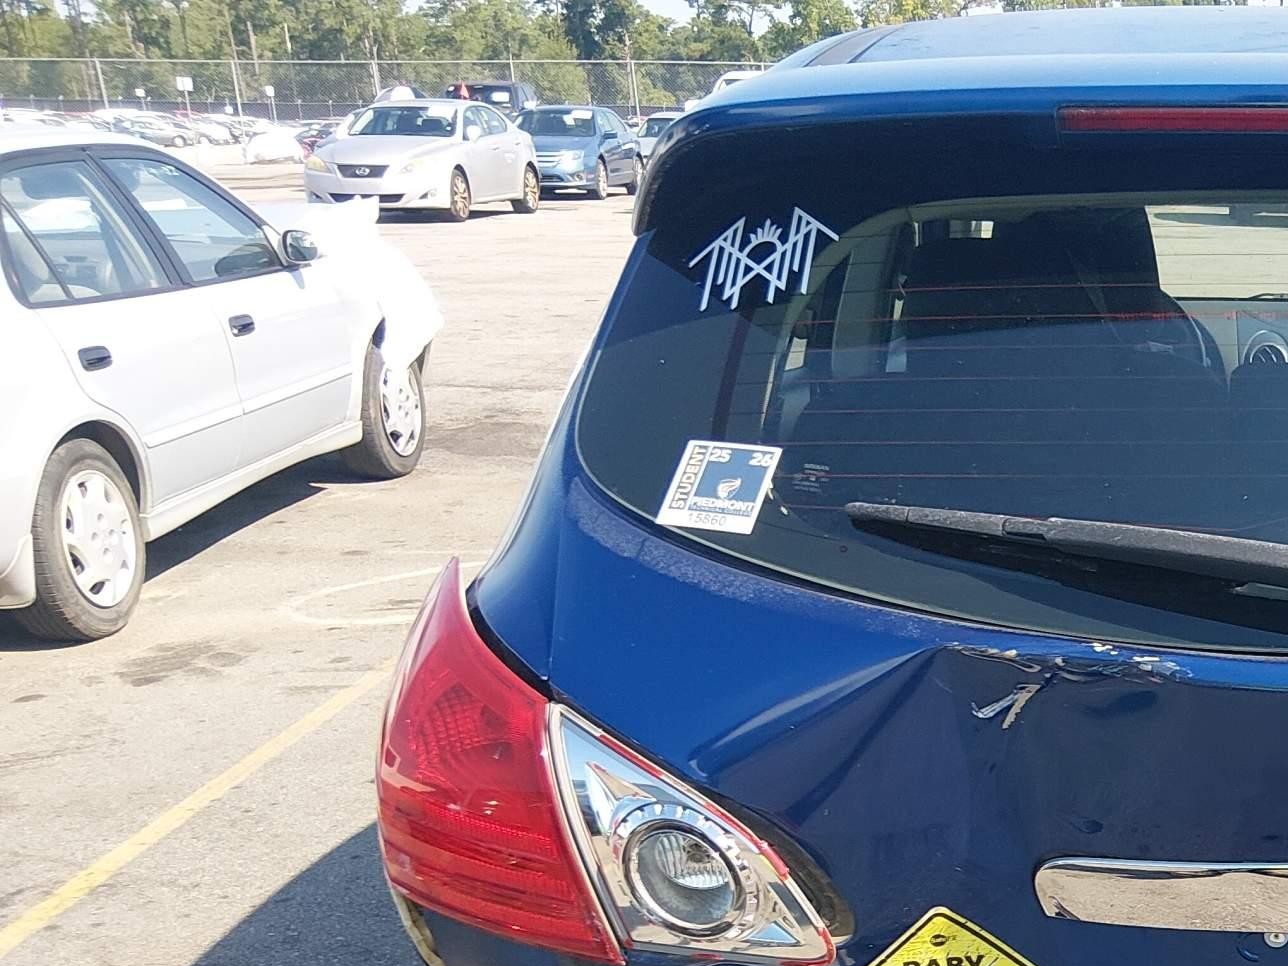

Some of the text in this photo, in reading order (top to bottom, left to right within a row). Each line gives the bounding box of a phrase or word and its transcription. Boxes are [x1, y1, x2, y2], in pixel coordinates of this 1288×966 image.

[670, 446, 707, 509] STUDENT
[708, 448, 775, 467] 25 26
